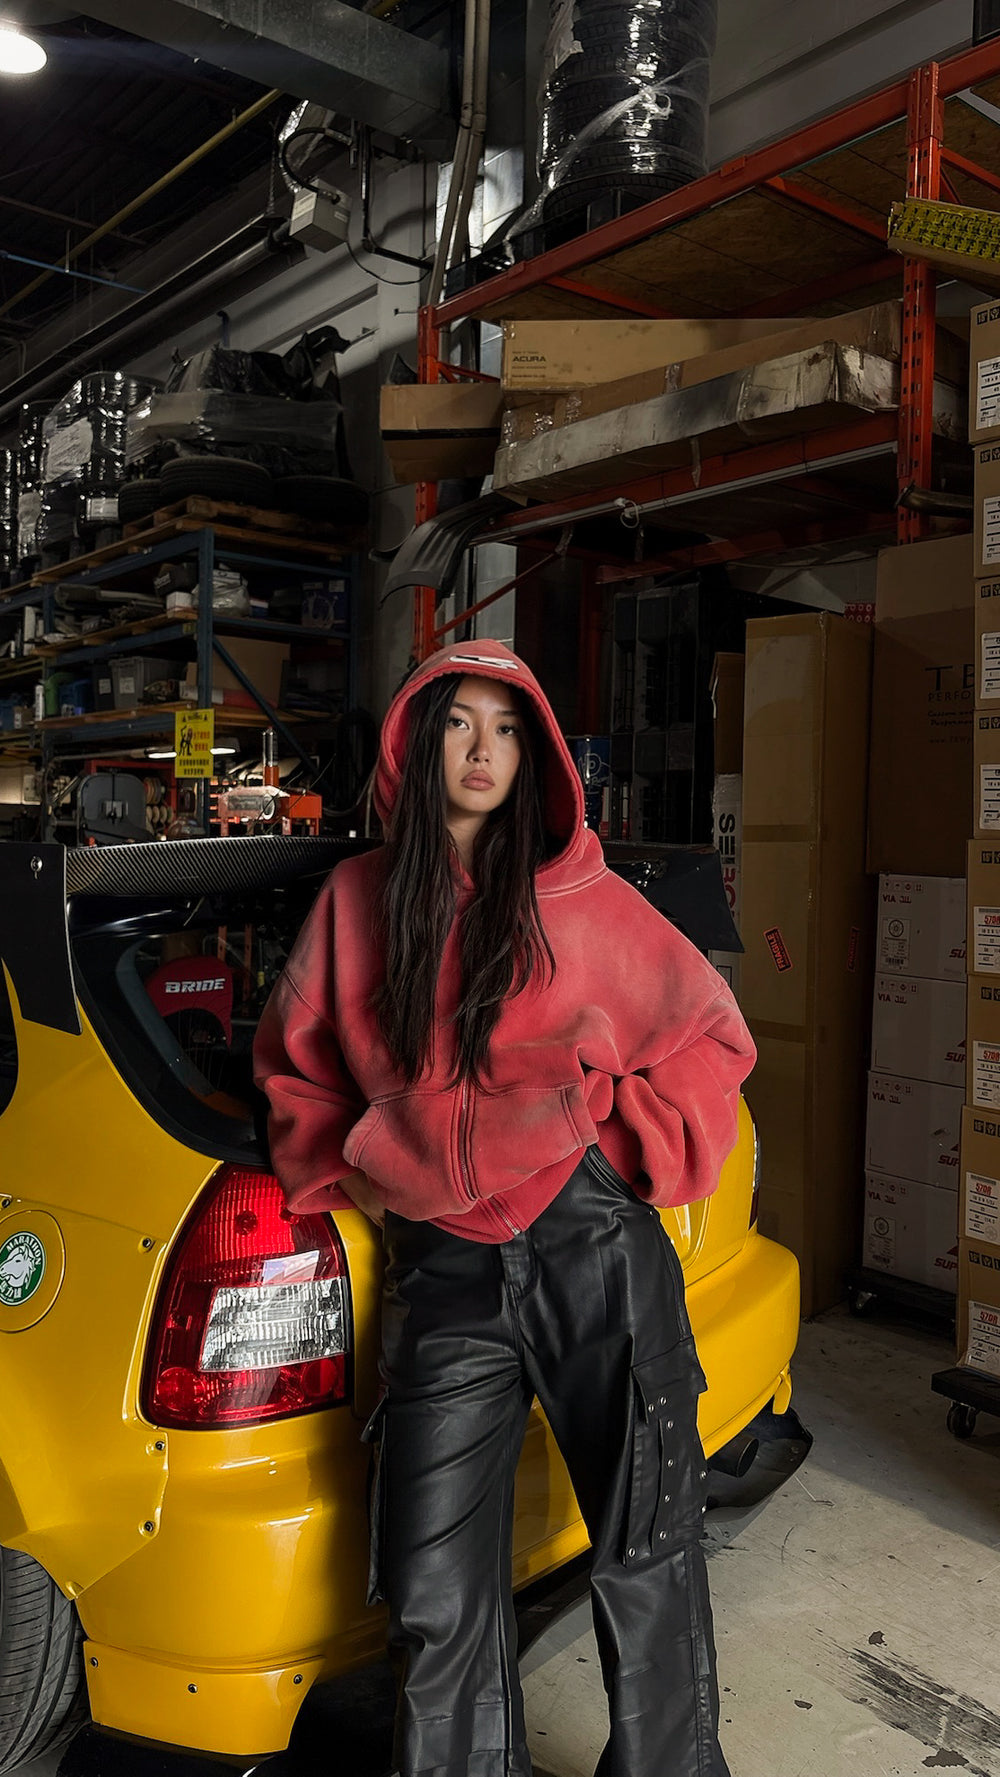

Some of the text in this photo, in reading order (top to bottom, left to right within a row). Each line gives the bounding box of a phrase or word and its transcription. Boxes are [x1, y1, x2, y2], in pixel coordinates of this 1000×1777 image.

[718, 813, 736, 917] SEIBO
[767, 934, 786, 970] FRAGILE
[165, 978, 226, 993] BRIDE
[878, 993, 891, 1002] VIA
[873, 1091, 885, 1101] VIA
[868, 1190, 881, 1201] VIA
[7, 1236, 41, 1265] MARATHON
